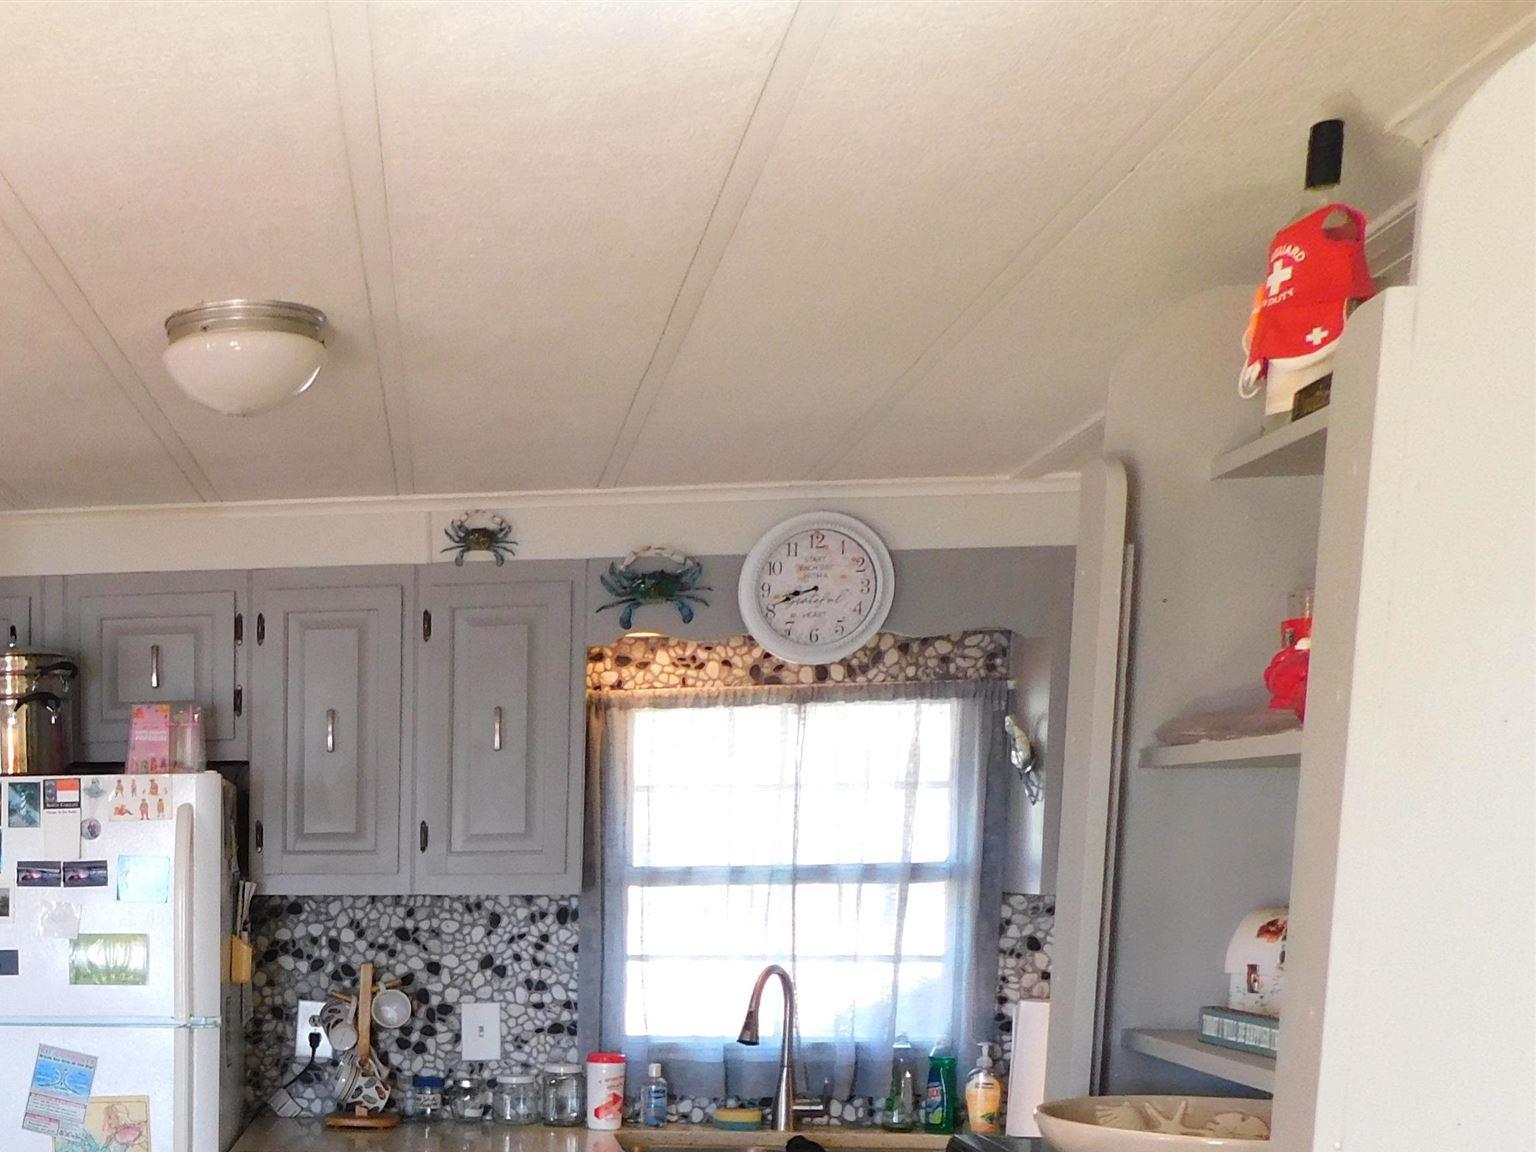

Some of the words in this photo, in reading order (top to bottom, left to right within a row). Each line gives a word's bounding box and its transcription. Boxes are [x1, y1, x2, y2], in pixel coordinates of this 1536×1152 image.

[786, 542, 798, 557] 11
[809, 534, 826, 549] 12
[768, 560, 783, 576] 10
[855, 556, 866, 573] 2
[761, 582, 771, 598] 9
[860, 578, 871, 594] 3
[765, 602, 776, 618] 8
[852, 600, 863, 615] 4
[784, 620, 795, 637] 7
[835, 616, 846, 634] 5
[809, 627, 819, 643] 6
